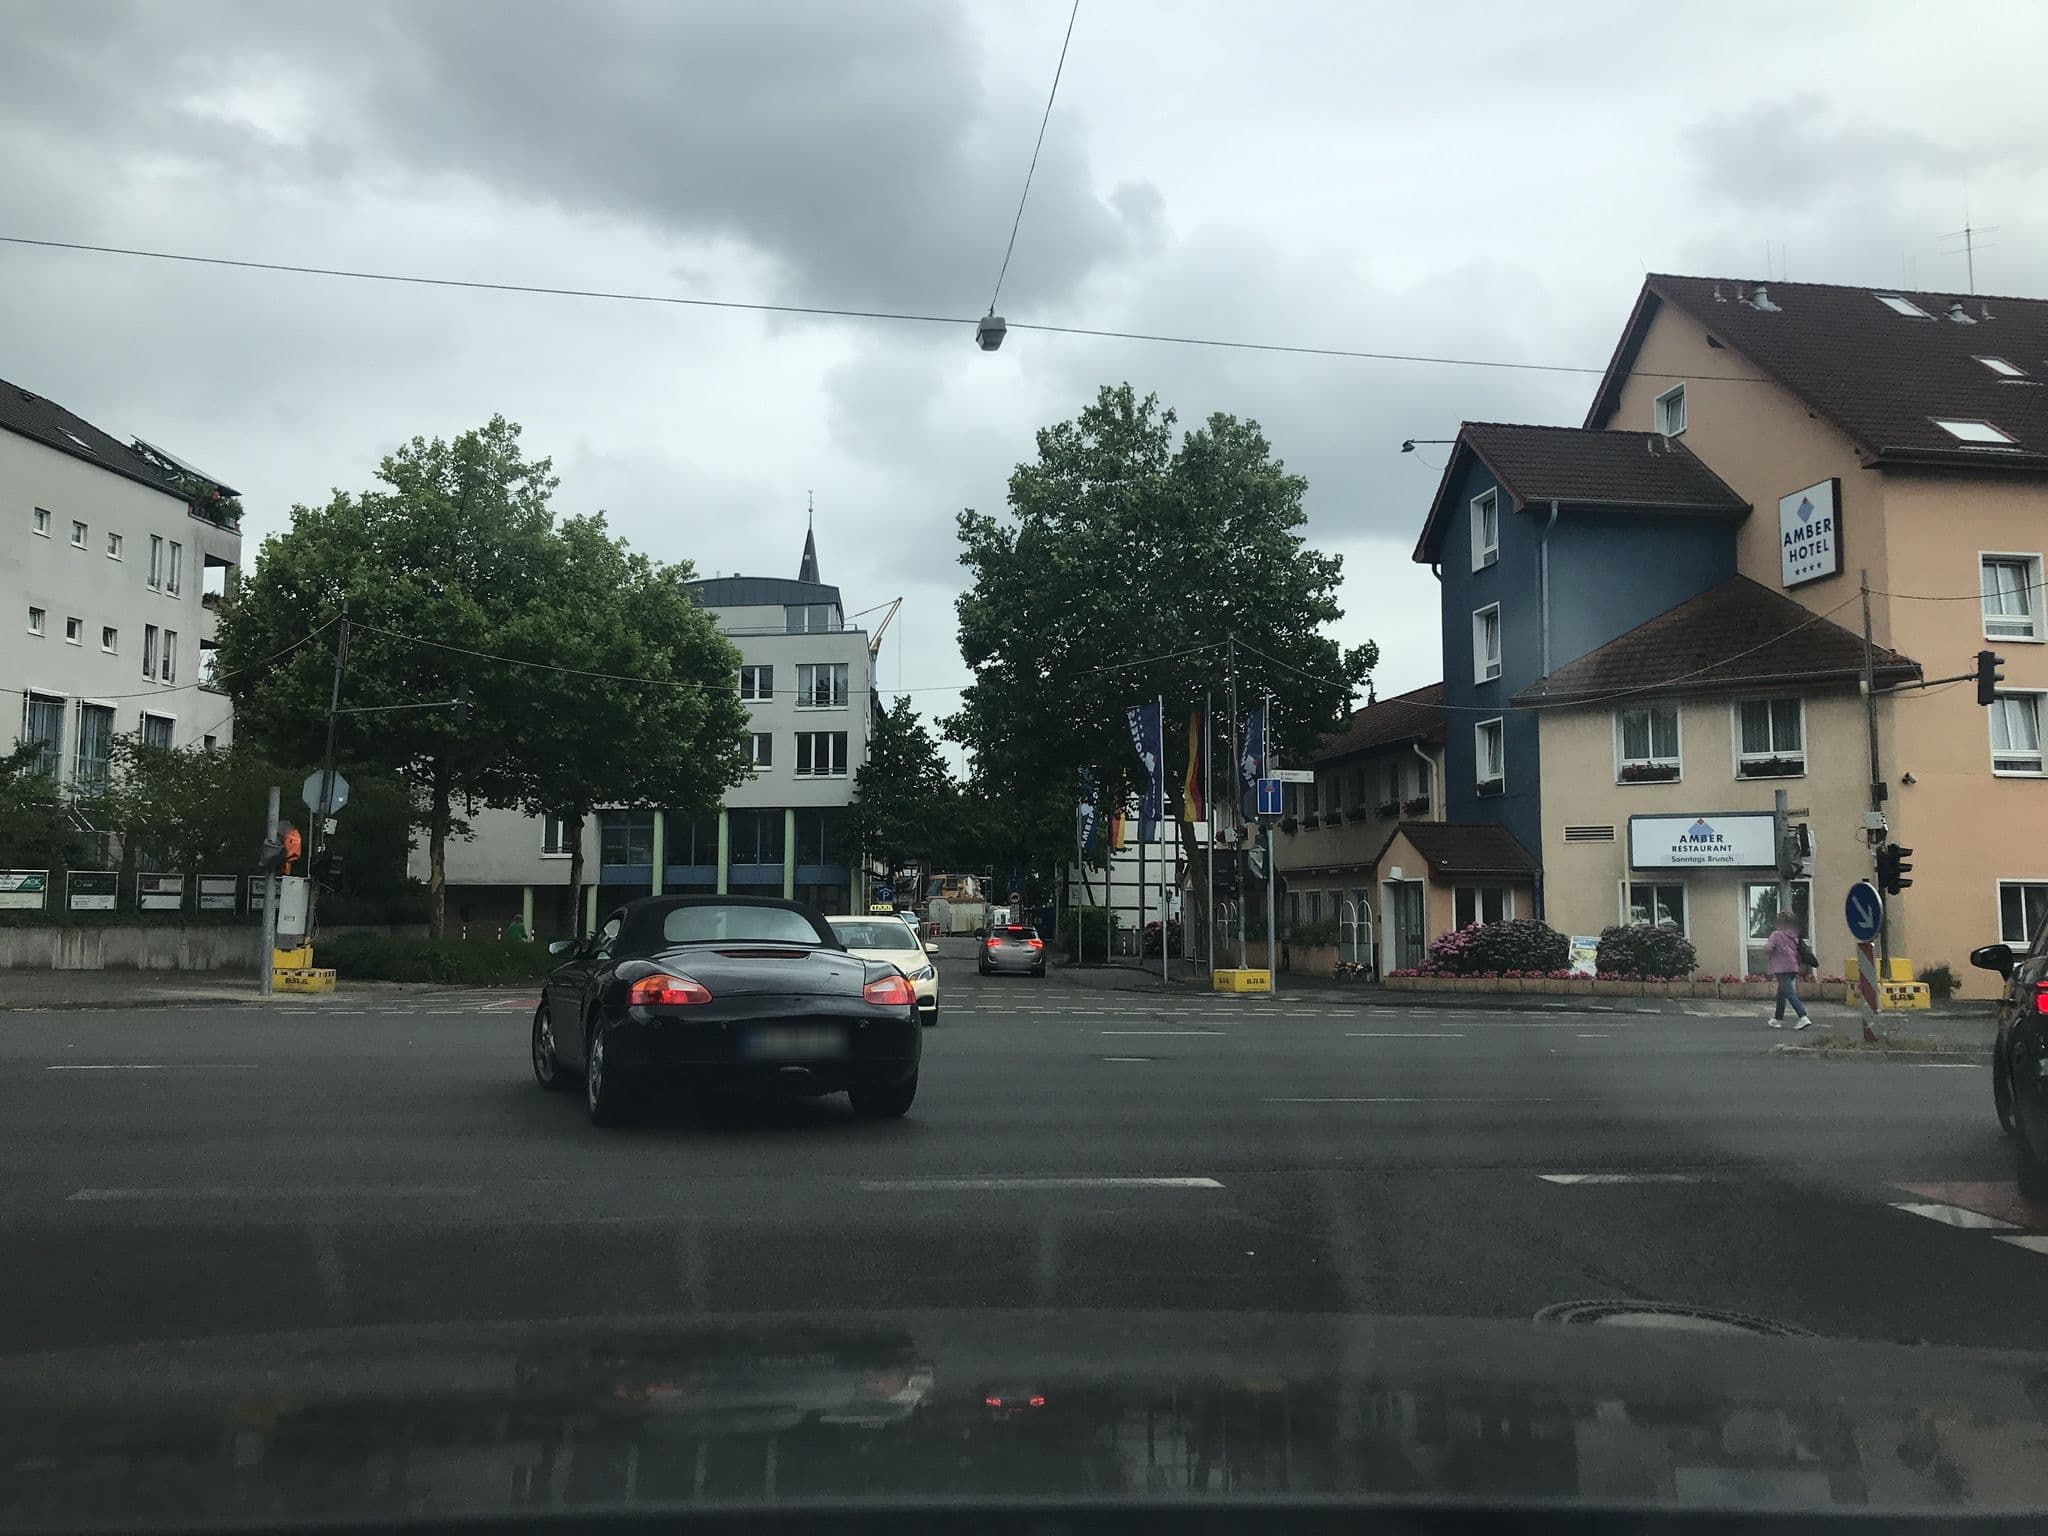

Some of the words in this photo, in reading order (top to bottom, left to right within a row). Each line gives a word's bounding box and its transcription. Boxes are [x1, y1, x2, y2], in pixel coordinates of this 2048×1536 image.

[1783, 518, 1832, 547] AMBER
[1789, 539, 1829, 563] HOTEL
[1679, 834, 1724, 843] AMBER
[1671, 845, 1733, 853] RESTAURANT
[1671, 855, 1706, 864] Sonntags
[1707, 854, 1734, 863] Brunch
